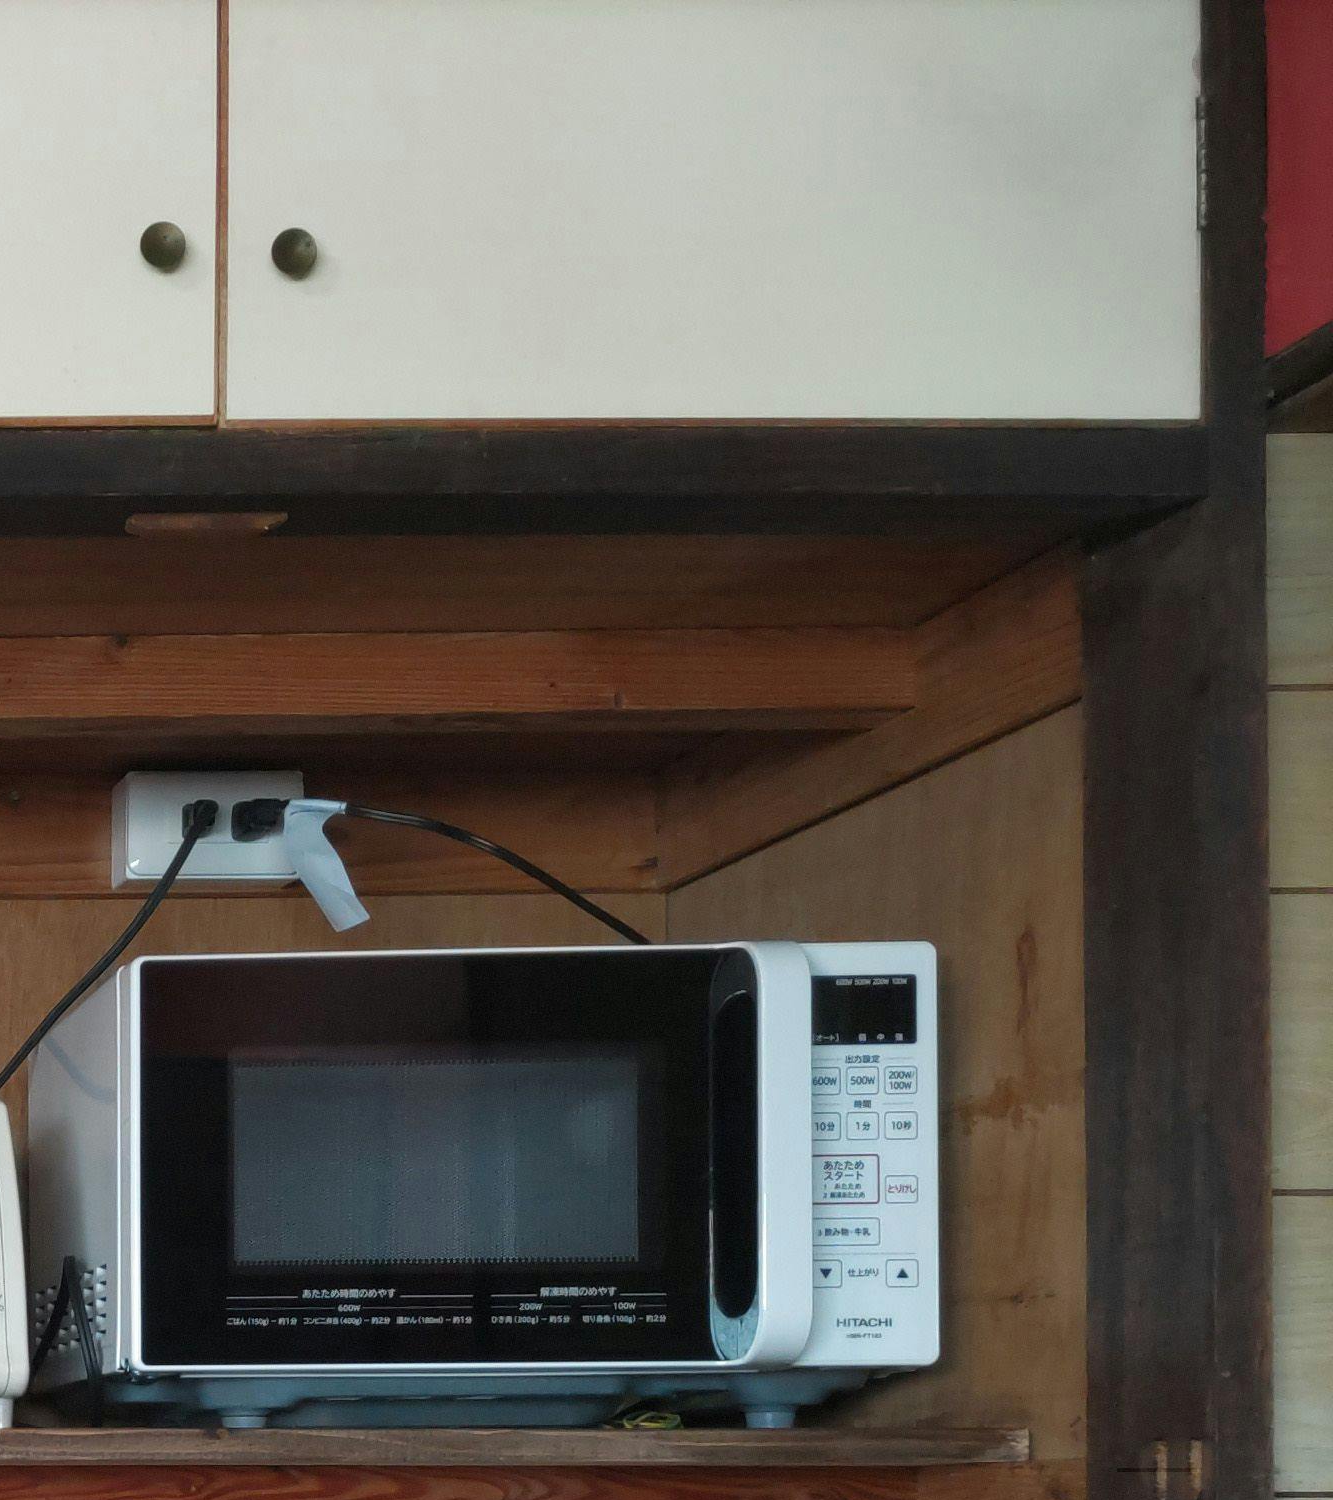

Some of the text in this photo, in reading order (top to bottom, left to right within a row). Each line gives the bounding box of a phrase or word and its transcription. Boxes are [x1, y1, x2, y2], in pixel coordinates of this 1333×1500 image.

[845, 1054, 880, 1063] 出力設定
[813, 1076, 837, 1086] 600W
[850, 1076, 875, 1085] 500W
[890, 1082, 912, 1090] 100W
[854, 1100, 872, 1108] 時間
[815, 1122, 835, 1131] 10分
[892, 1121, 912, 1130] 10秒
[823, 1160, 865, 1170] あたため
[824, 1171, 864, 1181] スタート
[887, 1184, 916, 1193] とりけし
[847, 1268, 879, 1277] 仕上がり
[302, 1289, 396, 1298] あたため時間のめやす
[540, 1287, 617, 1297] 解凍時間のめやす
[337, 1304, 361, 1312] 600W
[613, 1302, 636, 1310] 100W
[836, 1318, 892, 1327] HITACHI
